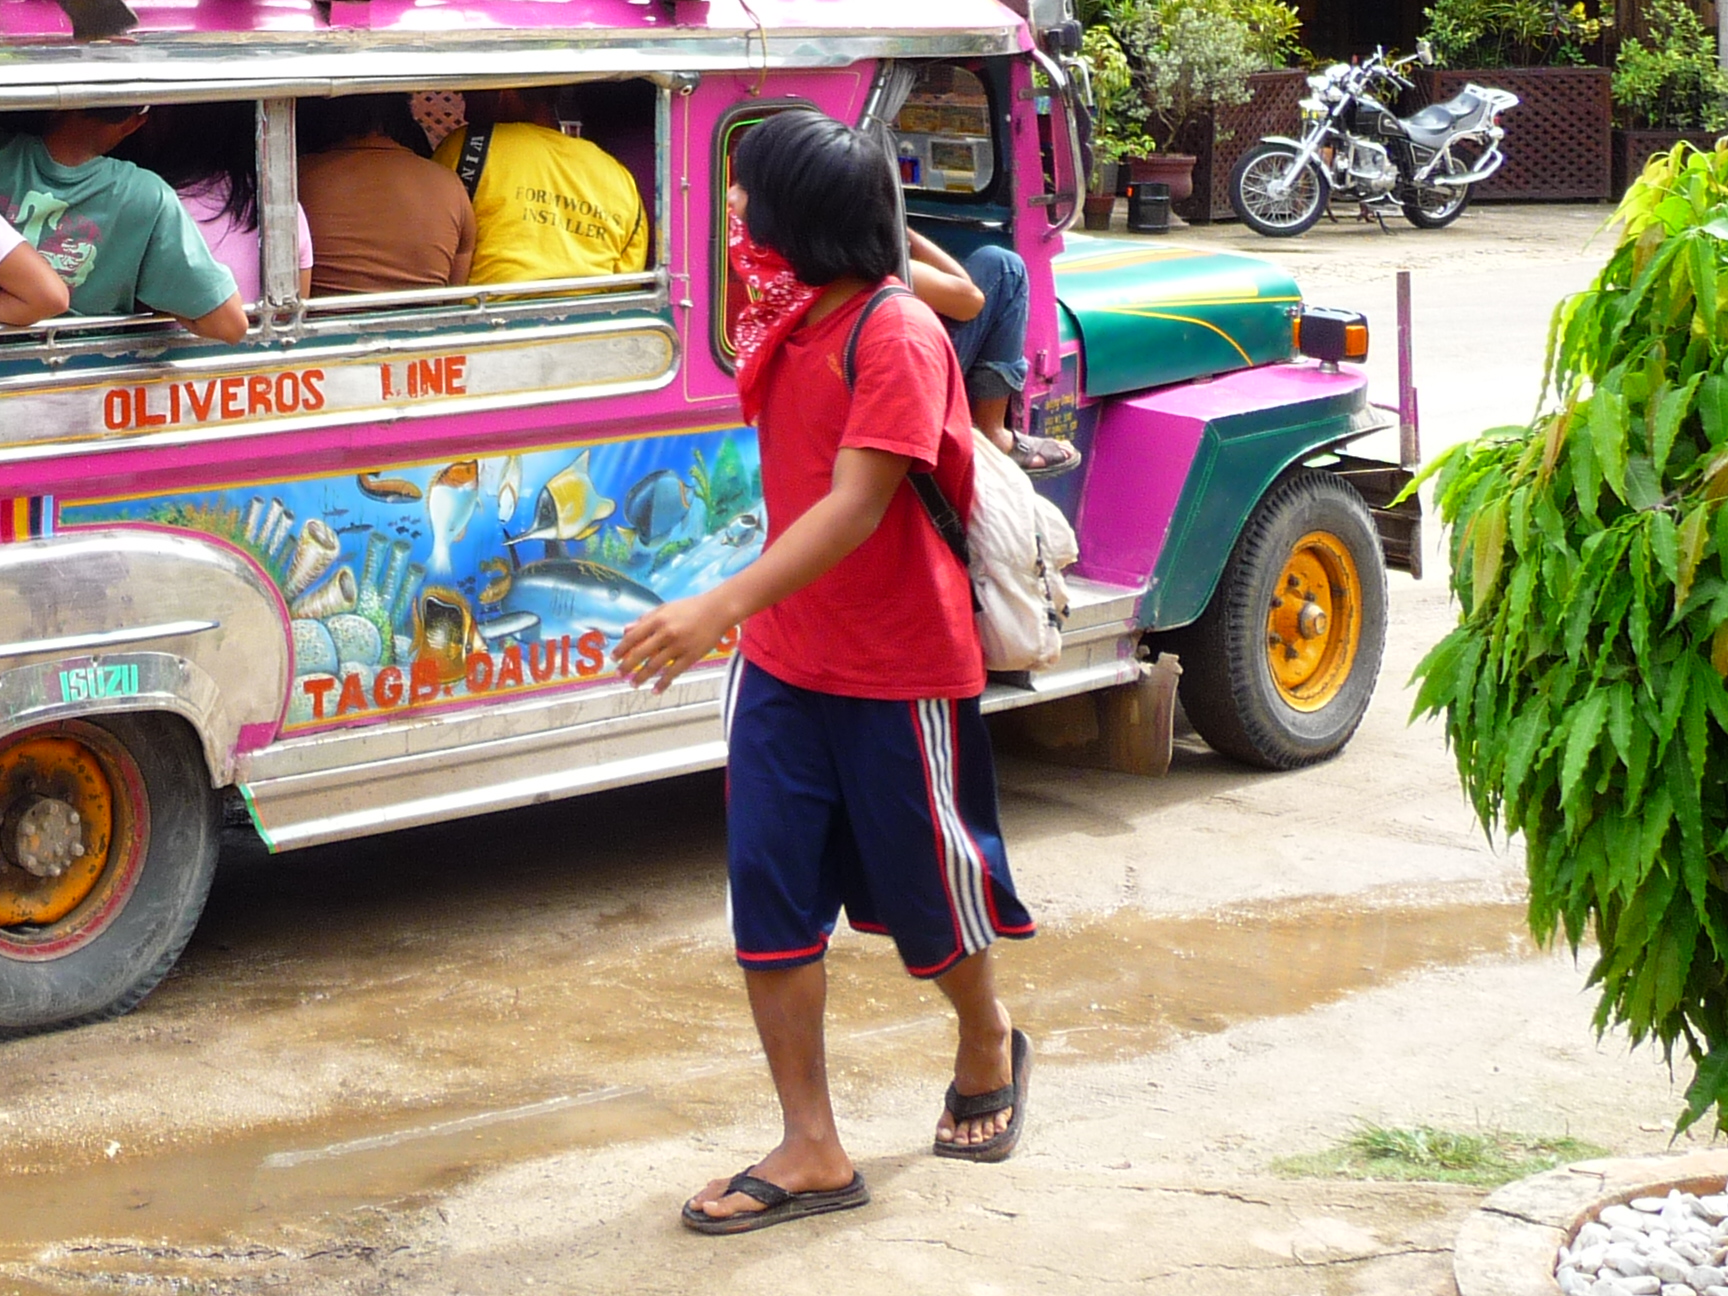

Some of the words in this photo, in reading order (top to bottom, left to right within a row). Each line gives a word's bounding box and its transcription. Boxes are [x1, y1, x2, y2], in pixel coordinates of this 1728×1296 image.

[515, 186, 622, 227] FORMWORS
[104, 369, 325, 430] OLIVEROS
[380, 355, 467, 401] LINE
[59, 664, 138, 703] ISUZU
